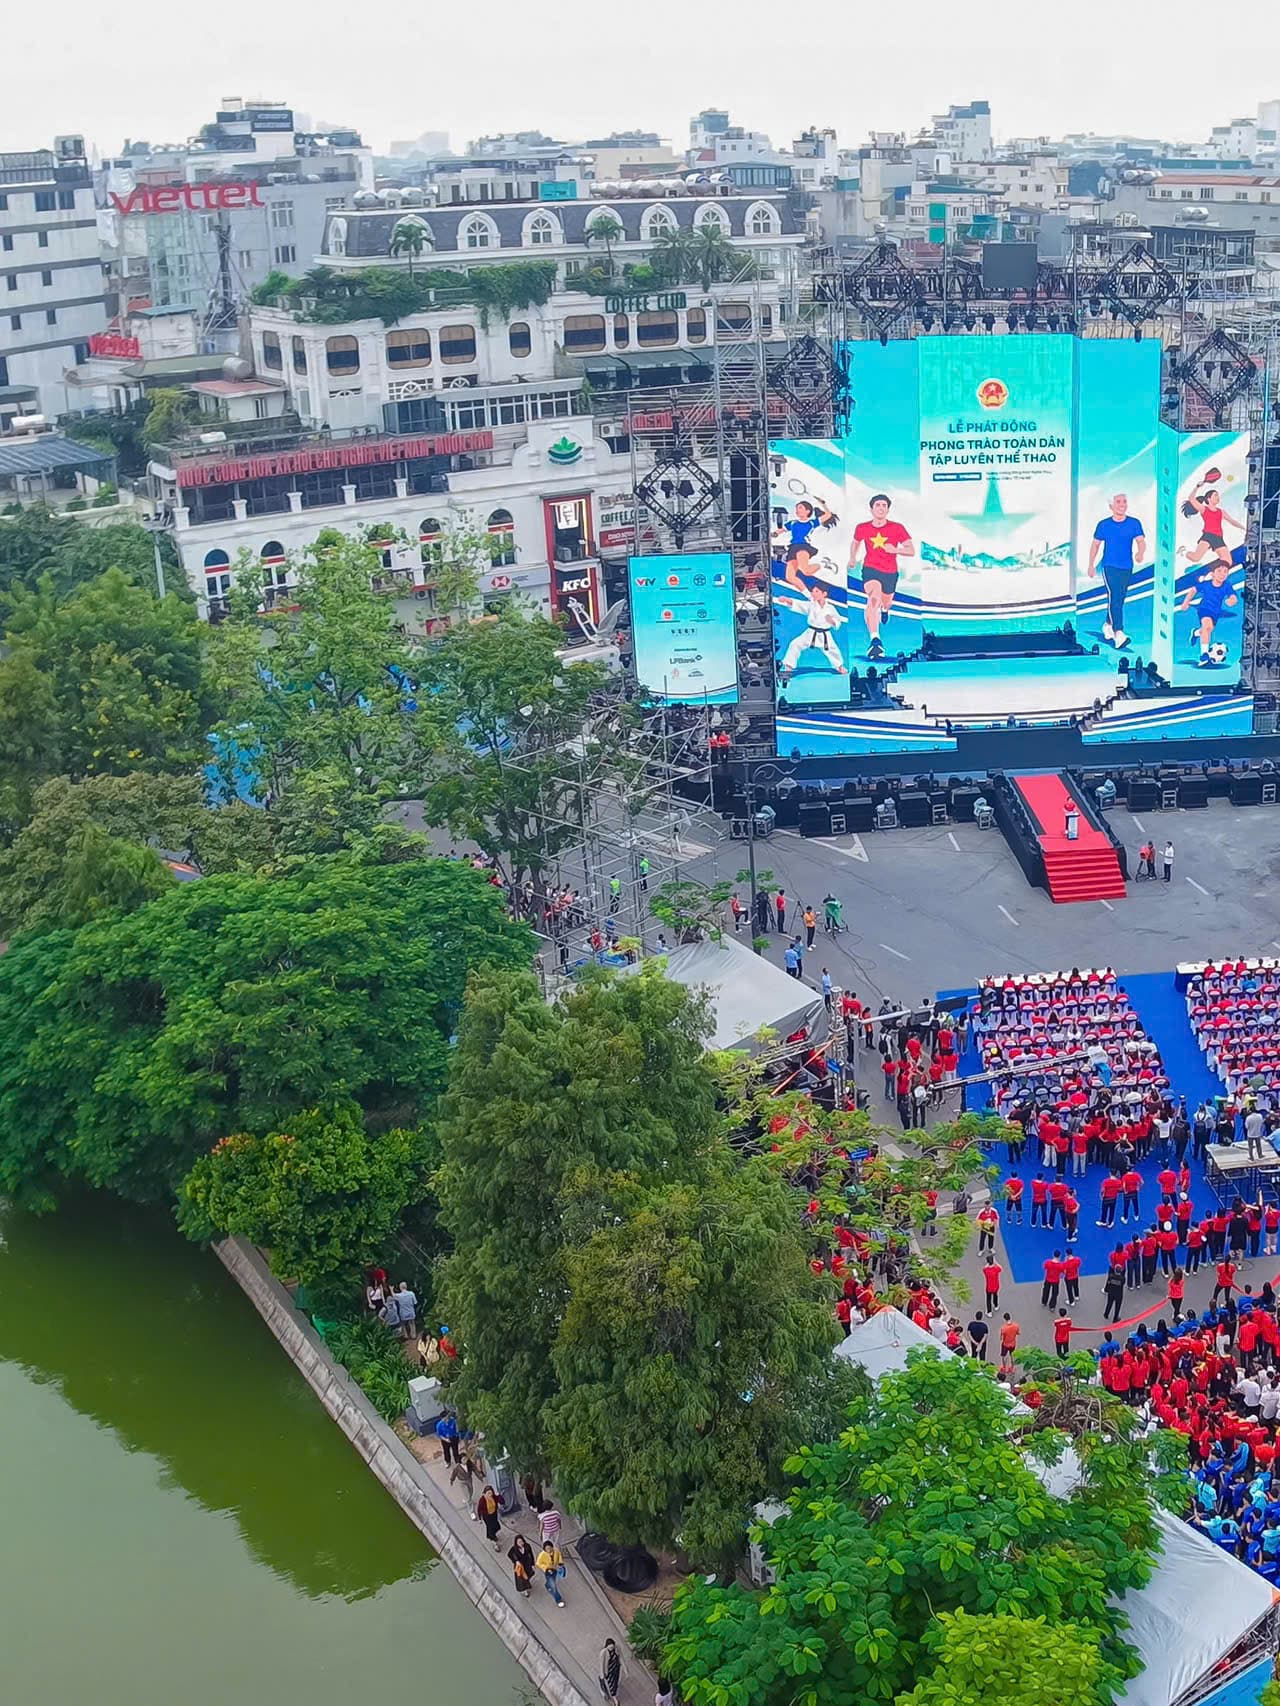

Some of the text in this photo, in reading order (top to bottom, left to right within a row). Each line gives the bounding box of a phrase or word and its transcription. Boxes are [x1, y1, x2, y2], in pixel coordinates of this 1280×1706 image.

[108, 180, 265, 214] viettel
[605, 294, 650, 313] COFFEE
[966, 420, 999, 433] PHÁT
[920, 435, 1065, 451] PHONG TRÀO TOÀN DÂN
[1022, 453, 1056, 463] THAO
[562, 577, 591, 592] KFC
